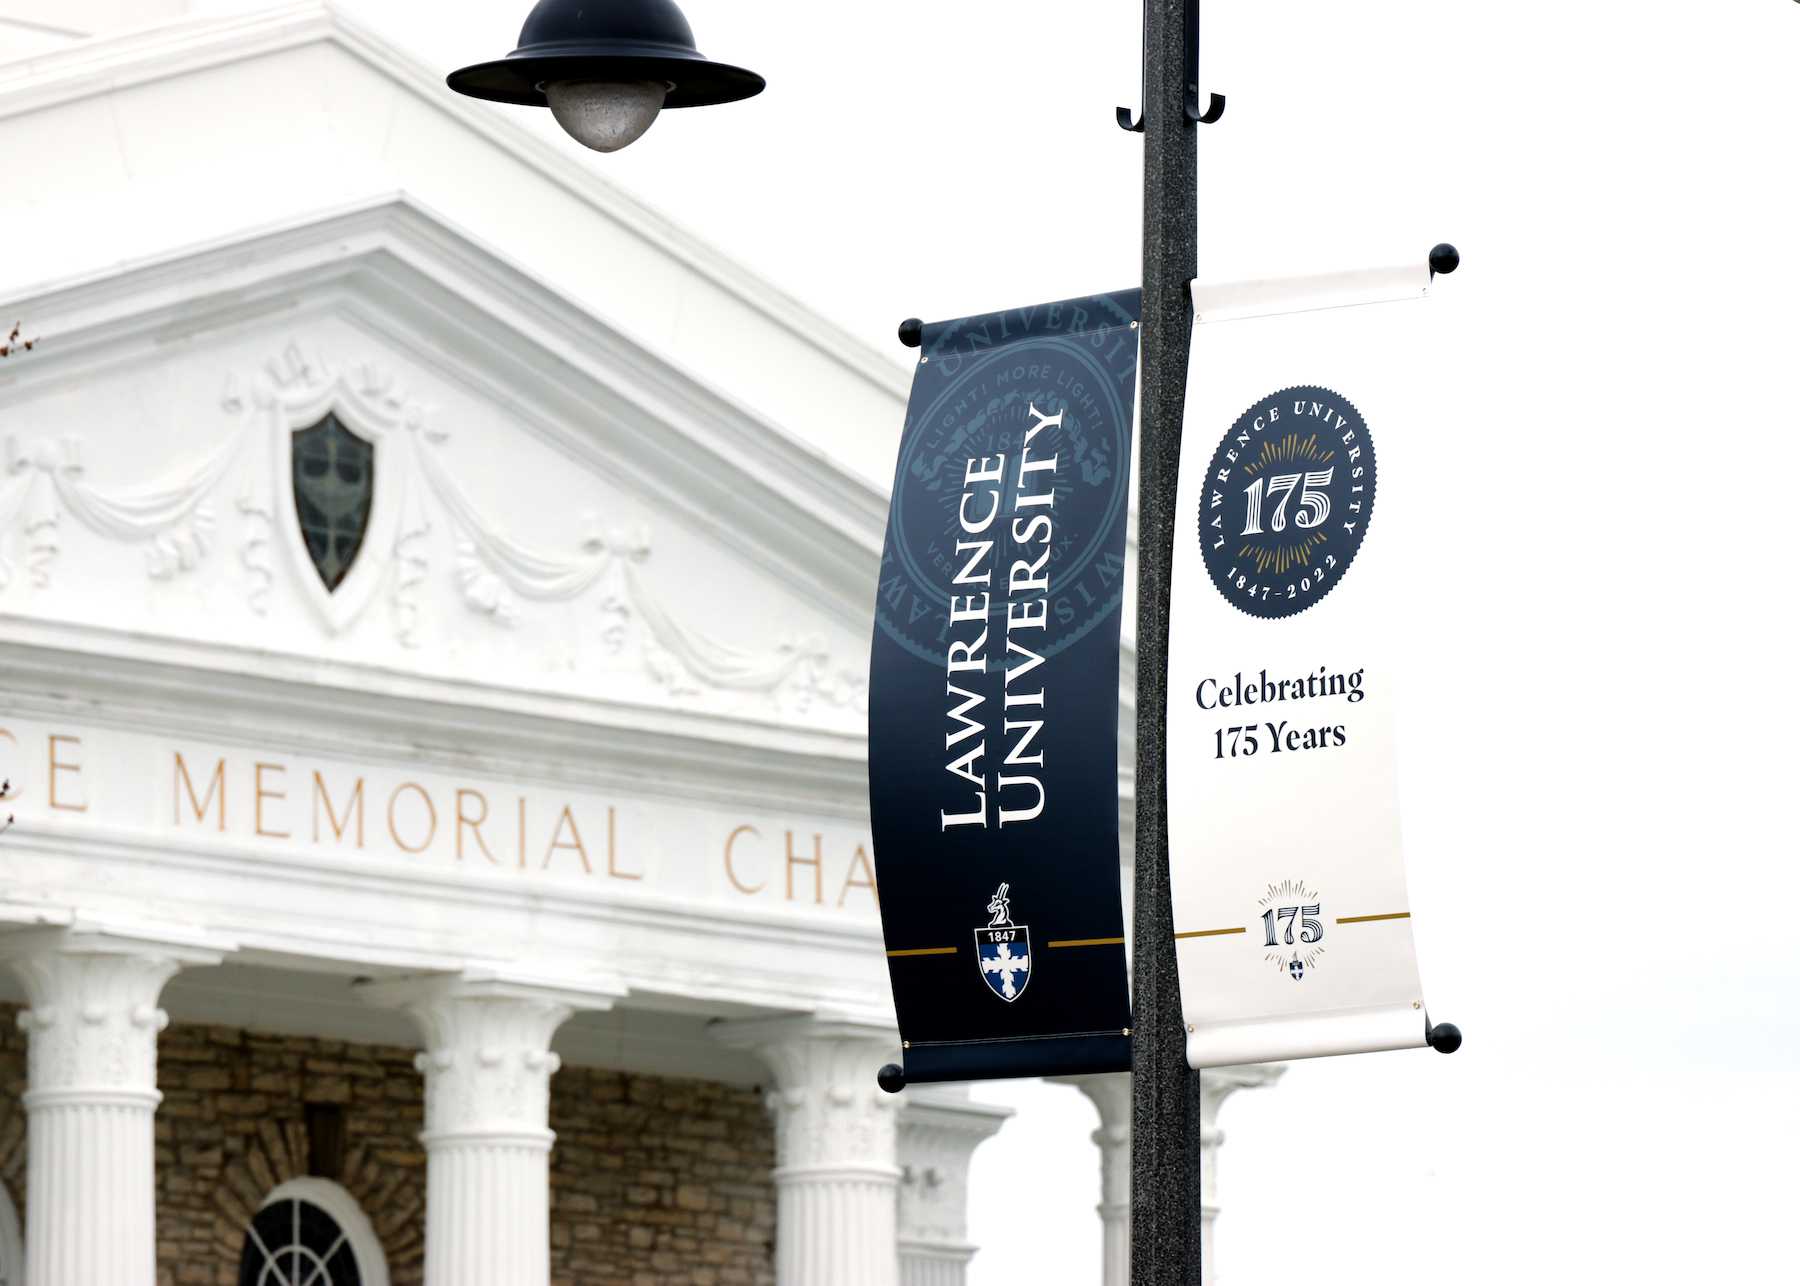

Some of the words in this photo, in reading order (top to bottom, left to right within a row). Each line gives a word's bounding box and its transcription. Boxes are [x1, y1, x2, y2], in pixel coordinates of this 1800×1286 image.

[936, 304, 1138, 411] UNIVERSIT
[998, 364, 1051, 386] MORE
[985, 431, 1025, 453] 184
[1211, 406, 1280, 550] LAWRENCE
[1294, 400, 1364, 535] UNIVERSITY
[1240, 465, 1335, 536] 175
[941, 453, 1006, 832] LAWRENCE
[998, 402, 1064, 829] UNIVERSITY
[1195, 665, 1365, 710] Celebrating
[1213, 723, 1259, 759] 175
[1265, 720, 1347, 753] Years
[173, 750, 644, 881] MEMORIAL
[988, 930, 1016, 943] 1847
[1261, 902, 1324, 947] 175
